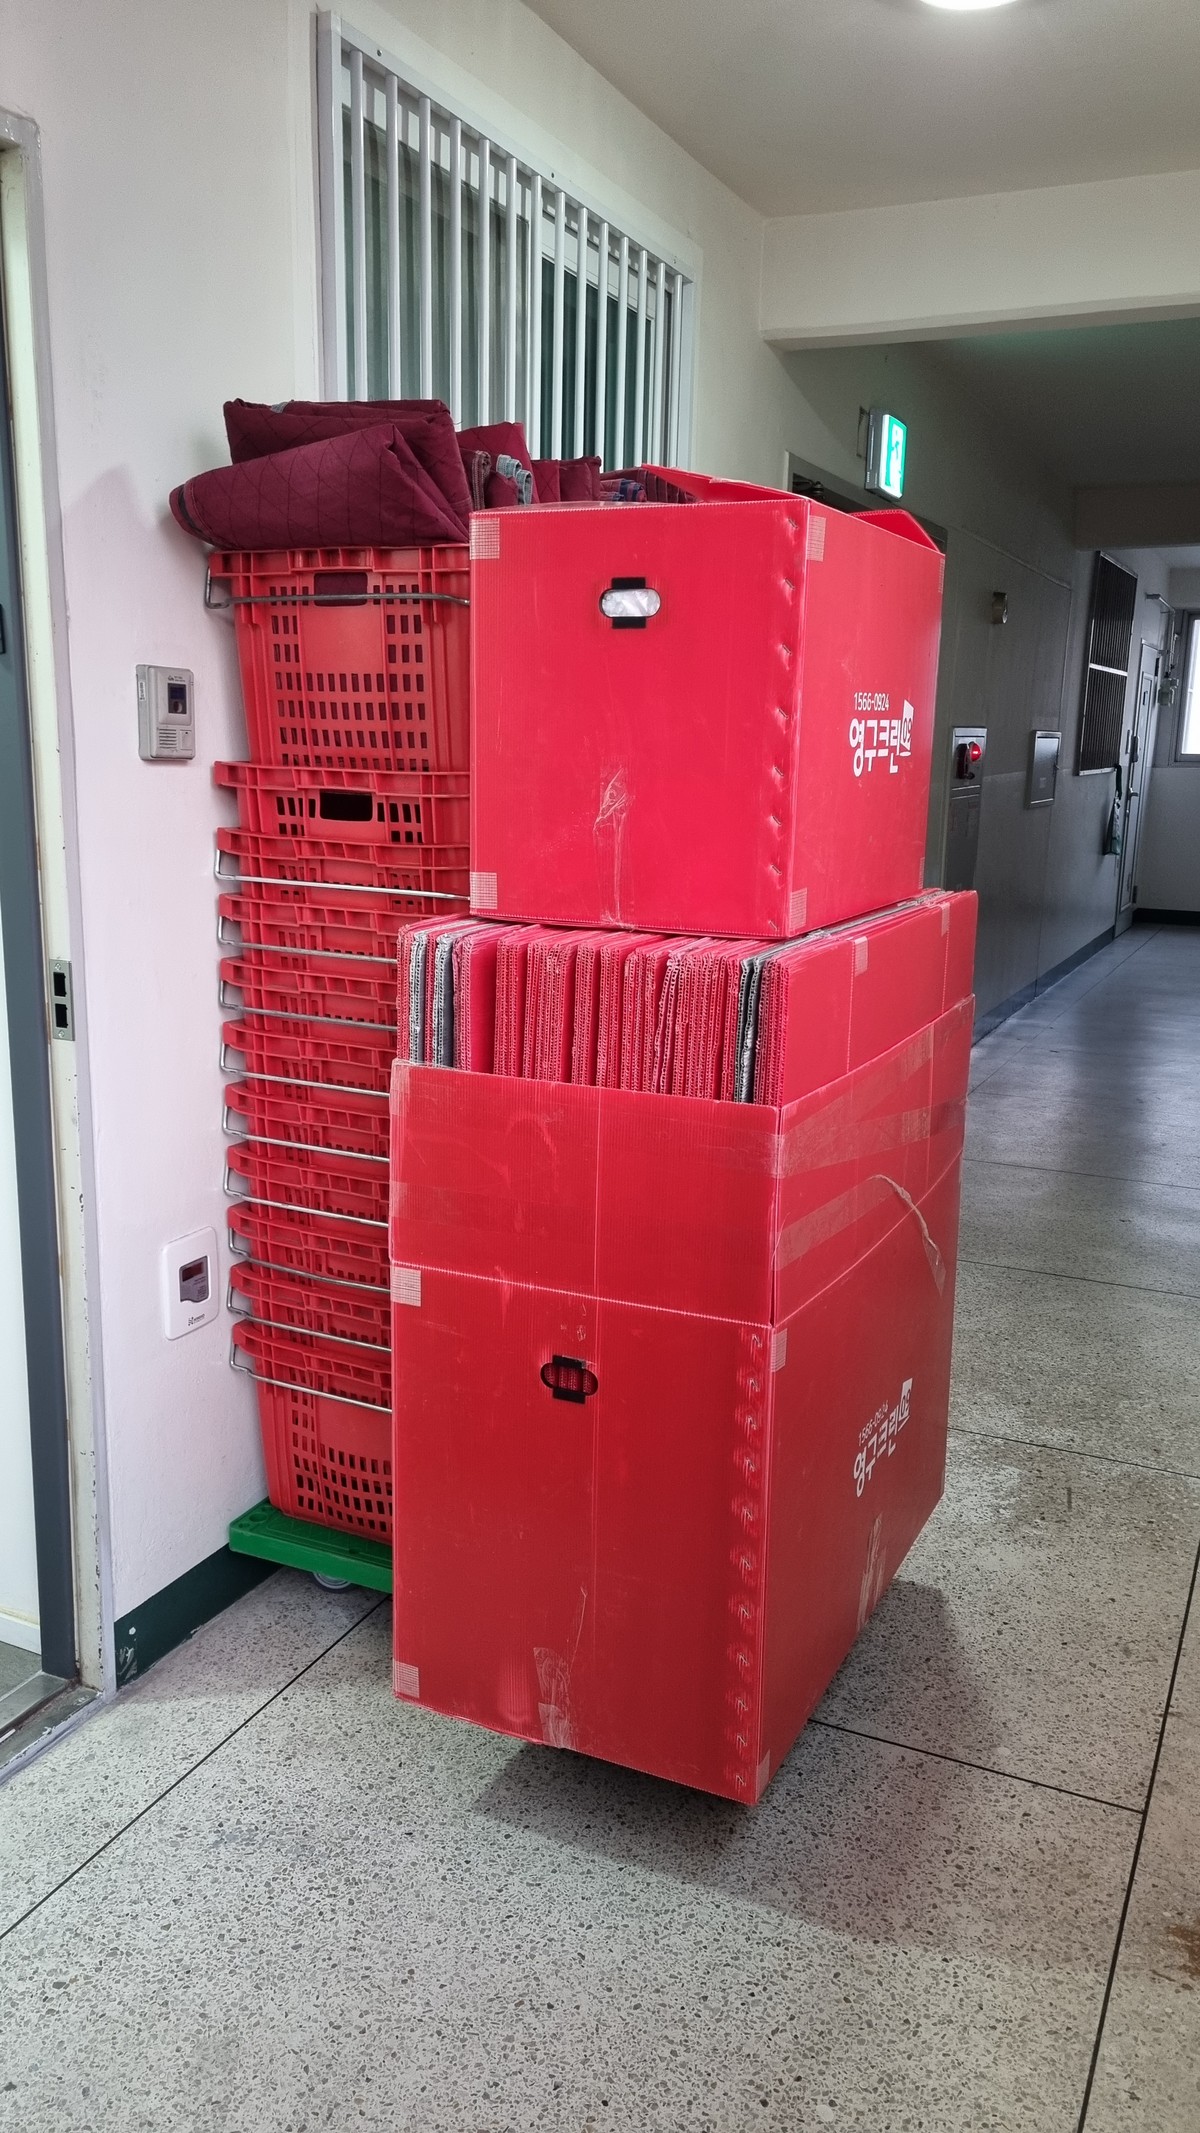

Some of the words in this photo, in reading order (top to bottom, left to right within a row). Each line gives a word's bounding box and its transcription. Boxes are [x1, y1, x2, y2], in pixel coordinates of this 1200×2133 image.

[853, 691, 890, 711] 1566-0924
[849, 717, 901, 777] 영구크린
[853, 1404, 900, 1498] 영구크린
